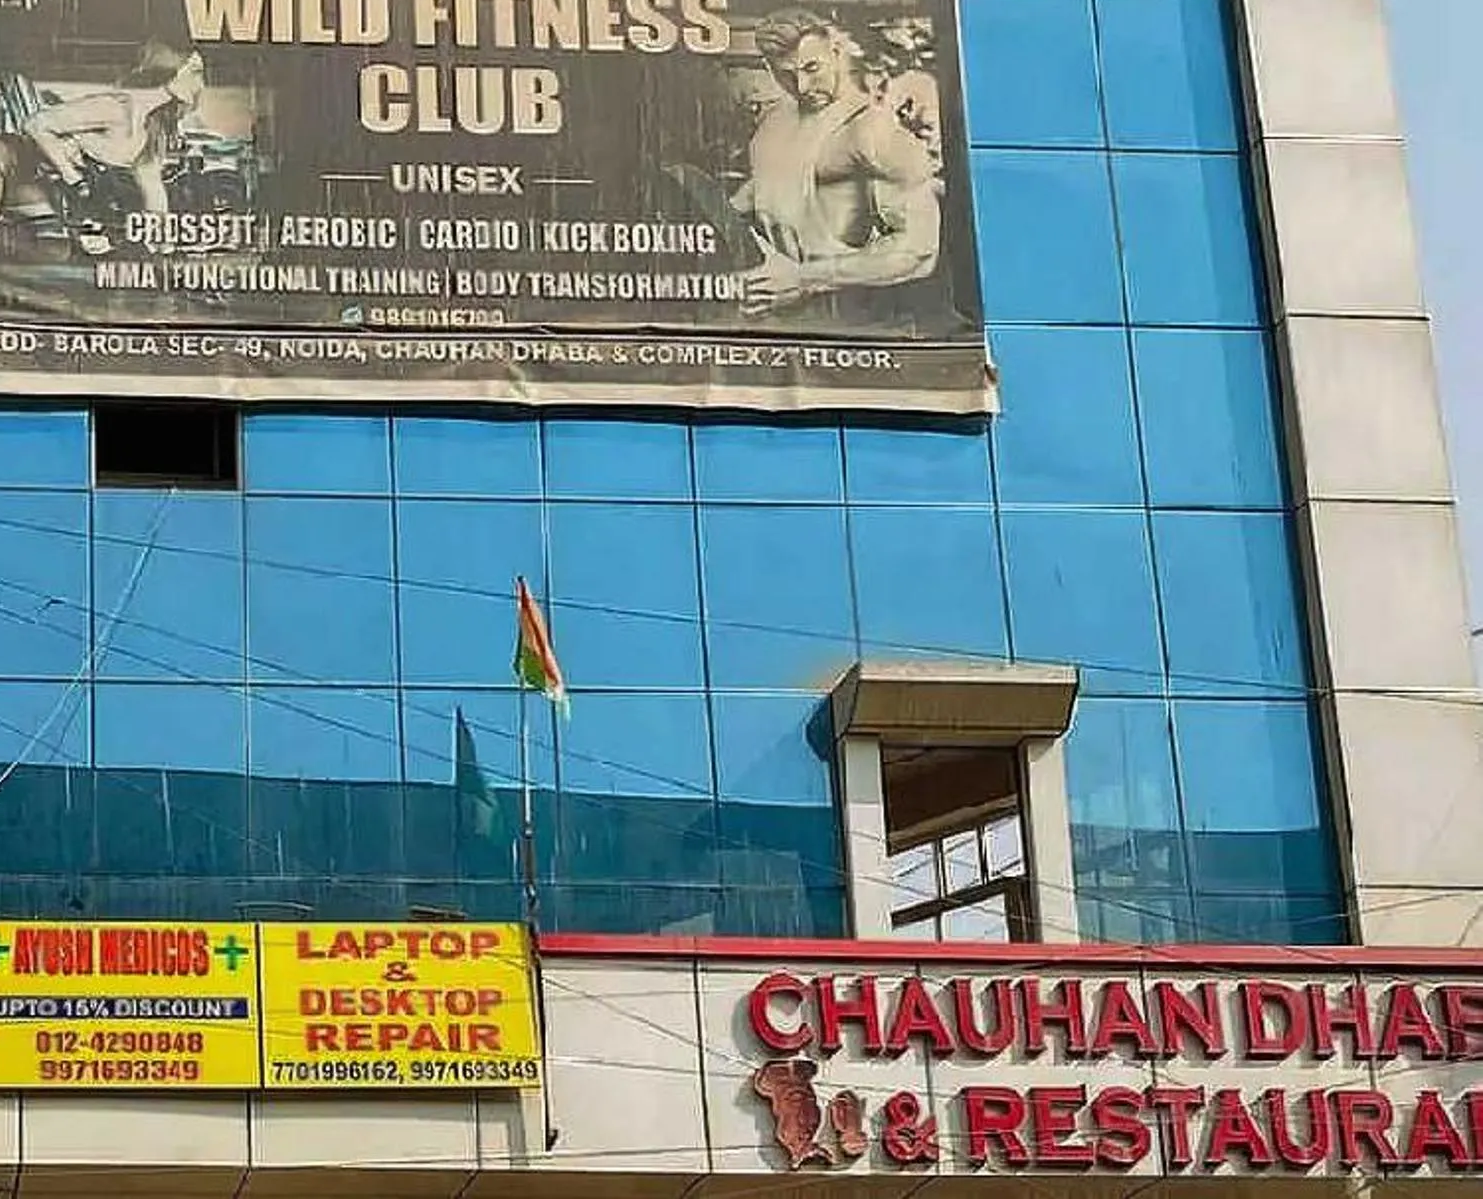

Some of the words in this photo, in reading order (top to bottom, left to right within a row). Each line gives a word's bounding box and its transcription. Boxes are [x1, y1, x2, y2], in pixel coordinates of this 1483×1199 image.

[357, 62, 563, 136] CLUB
[392, 164, 524, 196] UNISEX
[126, 212, 257, 245] CROSSFIT
[279, 216, 397, 249] AEROBIC
[419, 219, 520, 251] CARDIO
[542, 222, 611, 252] KICK
[614, 223, 716, 254] BOXING
[95, 261, 157, 289] MMA
[172, 262, 322, 292] FUNCTIONAL
[326, 267, 439, 296] TRAINING
[456, 271, 521, 297] BODY
[527, 272, 747, 300] TRANSFORMATION
[54, 334, 159, 356] BAROLA
[280, 339, 367, 363] NOIDA,
[375, 340, 505, 362] CHAUHAN
[512, 343, 603, 364] DHABA
[613, 345, 628, 364] &
[638, 346, 762, 367] COMPLEX
[804, 349, 901, 370] FLOOR.
[13, 928, 93, 976] AYUSH
[99, 928, 210, 977] MEDICOS
[296, 930, 499, 960] LAPTOP
[382, 962, 416, 982] &
[115, 999, 234, 1018] DISCOUNT
[299, 988, 503, 1017] DESKTOP
[748, 970, 1227, 1061] CHAUHAN
[305, 1024, 503, 1053] REPAIR
[40, 1060, 199, 1080] 9971693349
[880, 1089, 940, 1164] &
[960, 1082, 1483, 1170] RESTAURA
